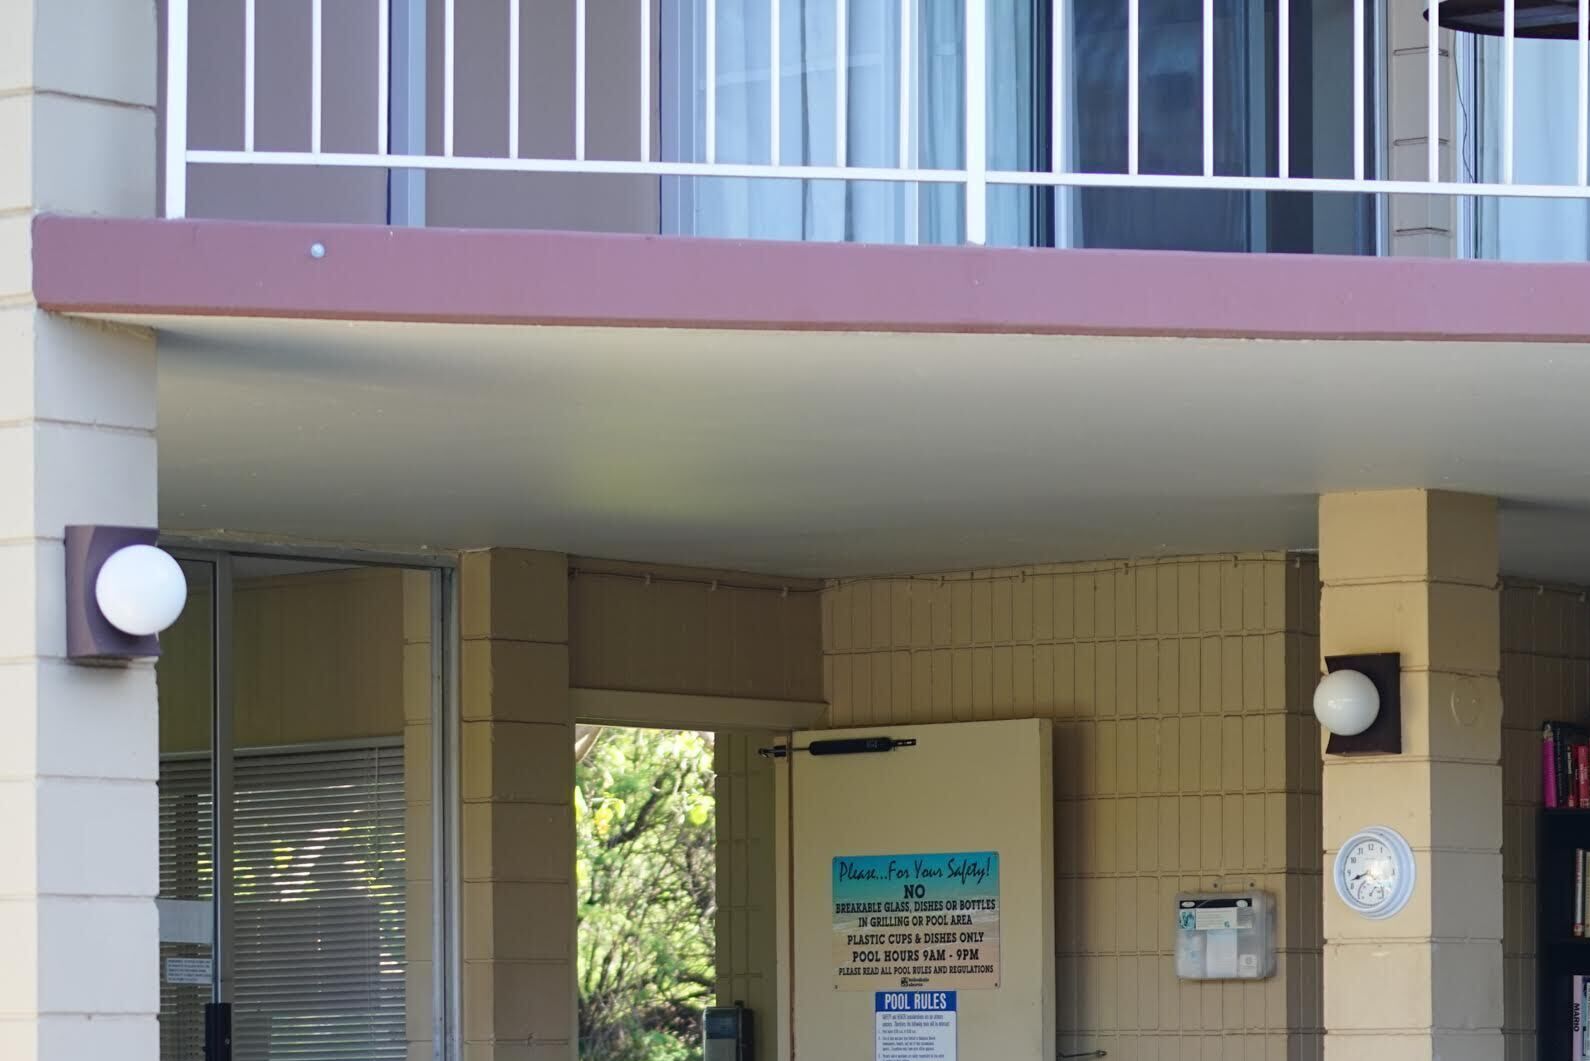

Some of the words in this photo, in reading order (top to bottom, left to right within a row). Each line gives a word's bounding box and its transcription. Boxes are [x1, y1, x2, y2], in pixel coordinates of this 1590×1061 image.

[1368, 843, 1374, 851] 12
[915, 859, 943, 879] Your
[947, 856, 991, 885] Safety!
[904, 884, 925, 898] NO
[836, 902, 882, 913] BREAKABLE
[884, 901, 912, 913] GLASS,
[914, 900, 944, 912] DISHES
[945, 900, 957, 911] OR
[960, 899, 996, 911] BOTTLES
[859, 917, 868, 927] IN
[870, 916, 910, 927] GRILLING
[912, 916, 924, 926] OR
[926, 915, 949, 926] POOL
[951, 915, 973, 925] AREA
[848, 934, 886, 945] PLASTIC
[888, 934, 912, 944] CUPS
[915, 933, 922, 944] &
[924, 932, 957, 943] DISHES
[960, 932, 984, 943] ONLY
[853, 951, 881, 962] POOL
[884, 950, 919, 962] HOURS
[923, 949, 946, 961] 9AM
[957, 949, 979, 961] 9PM
[839, 967, 861, 976] PLEASE
[863, 967, 879, 975] READ
[881, 967, 893, 975] ALL
[894, 966, 911, 975] POOL
[913, 966, 932, 974] RULES
[934, 966, 947, 974] AND
[949, 965, 994, 974] REGULATIONS
[885, 993, 911, 1010] POOL
[914, 993, 947, 1010] RULES
